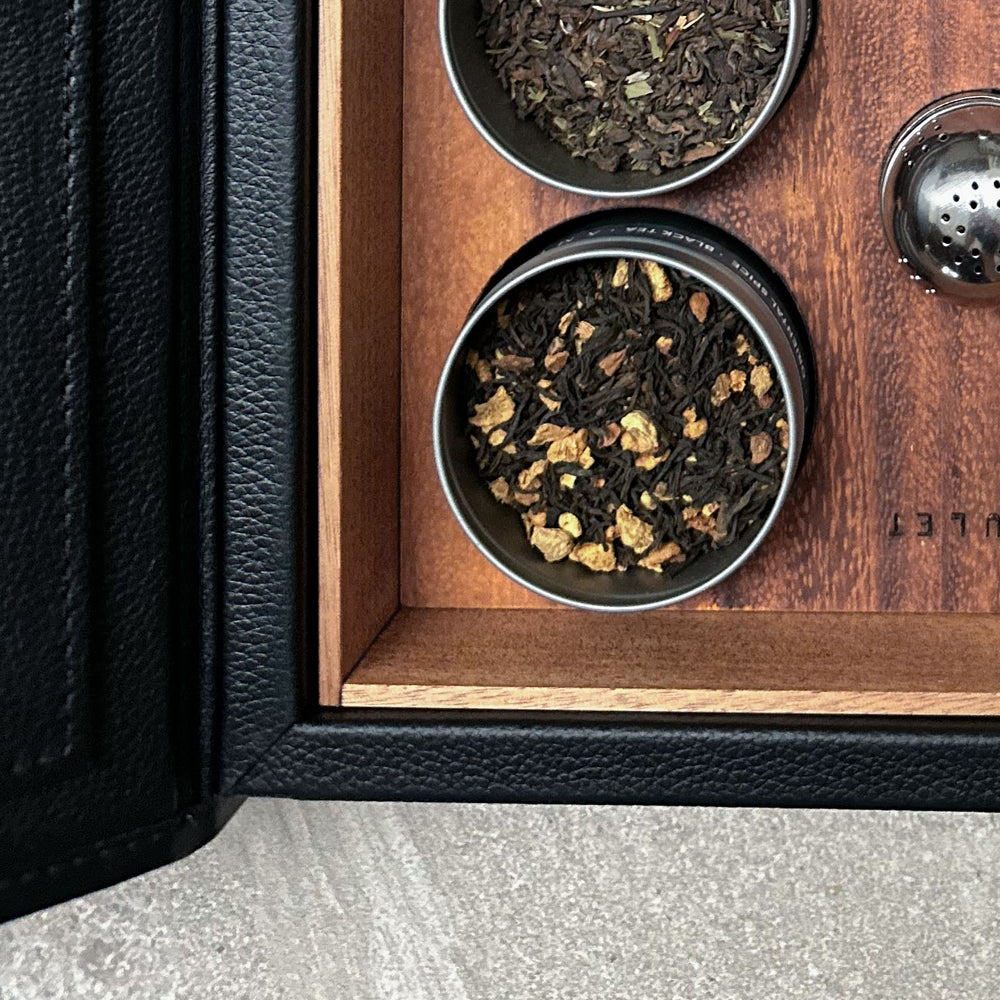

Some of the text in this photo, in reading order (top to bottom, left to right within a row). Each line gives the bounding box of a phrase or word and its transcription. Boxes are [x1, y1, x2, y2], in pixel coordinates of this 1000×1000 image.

[626, 226, 657, 234] TEA
[661, 229, 715, 252] BLACK
[731, 260, 768, 297] SPICE
